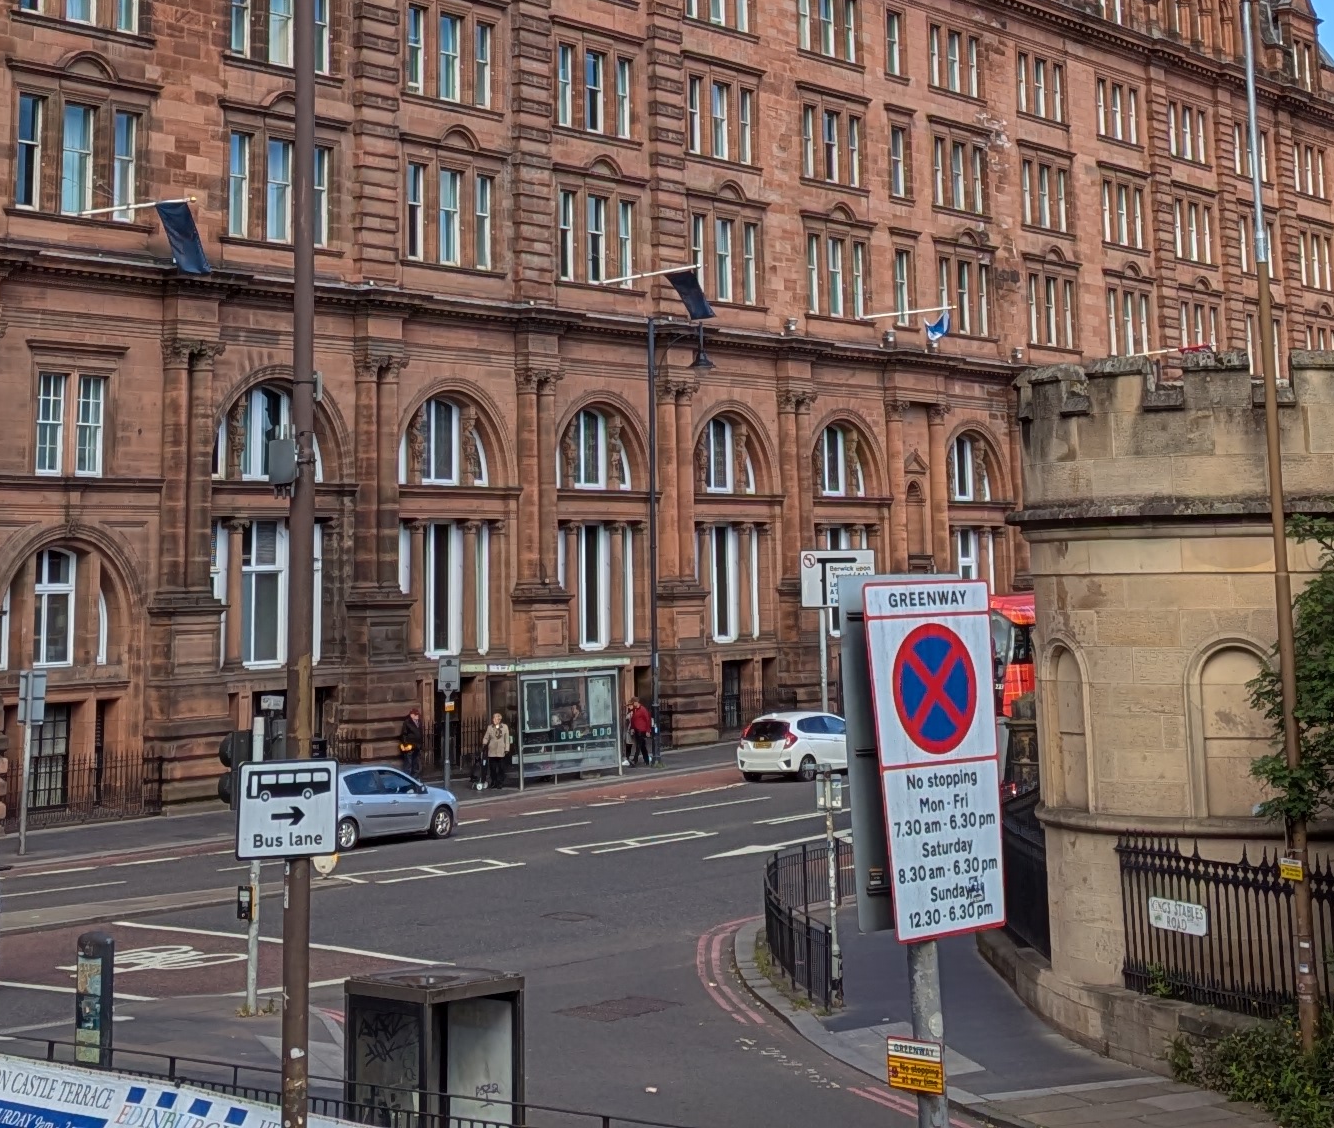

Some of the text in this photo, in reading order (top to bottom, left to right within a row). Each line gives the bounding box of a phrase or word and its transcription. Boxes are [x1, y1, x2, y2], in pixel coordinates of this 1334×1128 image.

[888, 590, 967, 608] GREENWAY
[906, 770, 978, 790] No stopping
[919, 797, 945, 814] Mon
[953, 793, 969, 809] Fri
[893, 819, 922, 838] 7.30
[924, 822, 941, 835] am
[949, 811, 977, 830] 6.30
[978, 812, 996, 830] pm
[252, 832, 323, 849] Bus lane
[922, 837, 974, 858] Saturday
[898, 865, 927, 884] 8.30
[928, 867, 946, 880] am
[953, 857, 980, 876] 6.30
[981, 857, 998, 875] pm
[930, 883, 972, 902] Sunday
[909, 909, 941, 929] 12.30
[949, 902, 975, 922] 6.30
[977, 902, 994, 919] pm
[1167, 916, 1187, 930] ROAD
[893, 1043, 935, 1057] GREENWAY
[11, 1072, 59, 1100] CASTLE
[59, 1080, 116, 1110] TERRACE
